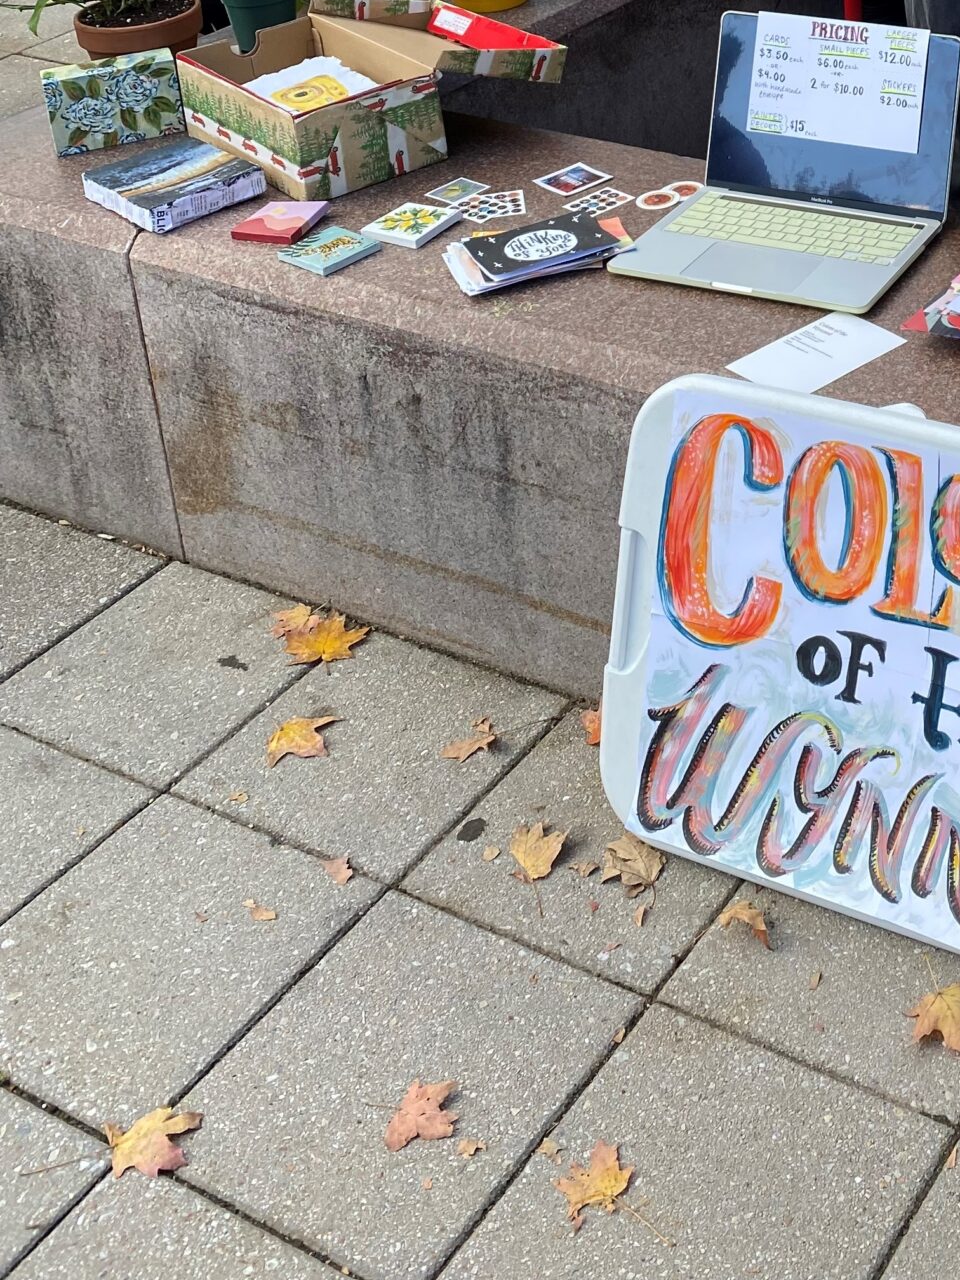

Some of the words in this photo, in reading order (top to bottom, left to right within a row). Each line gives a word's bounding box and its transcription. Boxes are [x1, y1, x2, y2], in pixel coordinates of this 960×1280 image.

[763, 33, 791, 45] CARDS
[810, 21, 870, 45] PRICING
[820, 44, 844, 53] SMALL
[846, 47, 870, 56] PIECES
[890, 40, 916, 50] PIECES
[817, 57, 844, 69] $6.00
[878, 50, 912, 67] $12.00
[757, 68, 786, 83] $4.00
[810, 77, 818, 90] 2
[820, 80, 830, 88] for
[833, 82, 864, 96] $10.00
[881, 79, 917, 93] STICKERS
[879, 95, 908, 109] $2.00
[790, 119, 806, 133] $15
